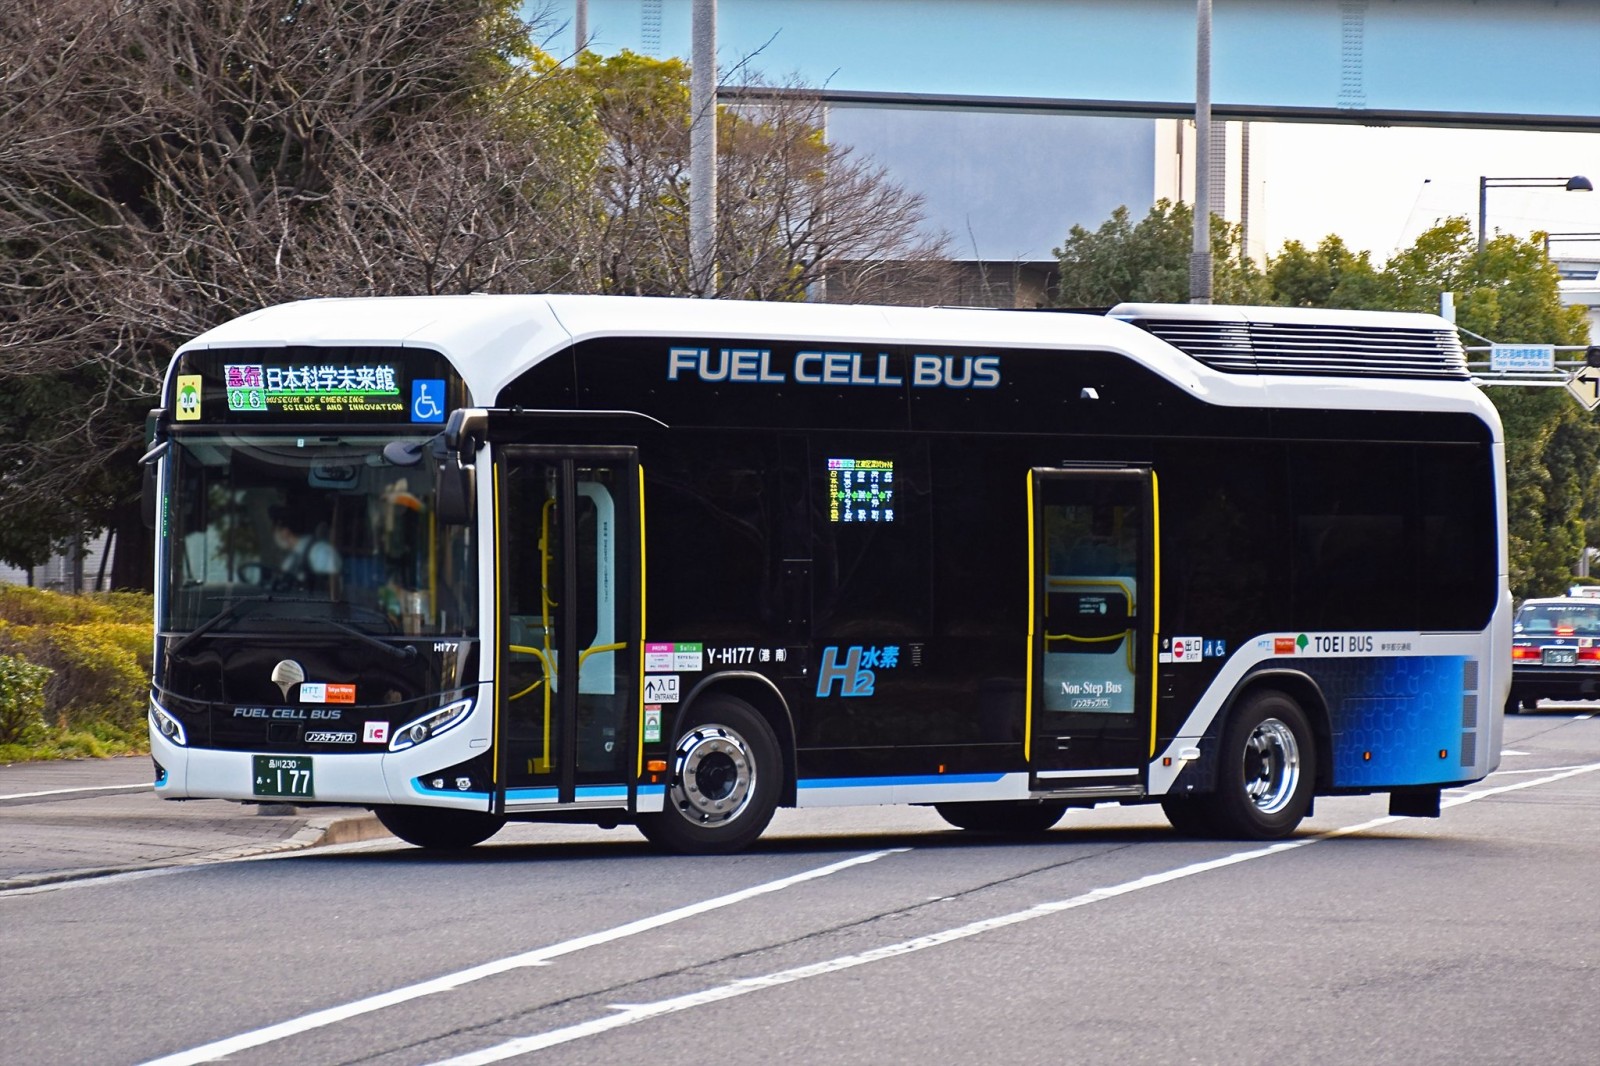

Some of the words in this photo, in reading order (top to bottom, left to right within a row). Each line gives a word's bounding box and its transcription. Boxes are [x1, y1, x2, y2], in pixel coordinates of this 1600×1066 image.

[668, 348, 786, 382] FUEL
[794, 352, 902, 385] CELL
[913, 355, 1000, 389] BUS
[228, 366, 261, 387] 急行
[266, 365, 396, 391] 日本科学未来館
[232, 390, 260, 408] 06
[320, 396, 365, 404] EMERGING
[433, 643, 459, 652] H177
[1185, 640, 1201, 651] 出口
[1315, 637, 1345, 653] TOEI
[1349, 636, 1373, 652] BUS
[707, 647, 755, 664] Y-H177
[861, 646, 899, 668] 水素
[657, 679, 676, 691] 入口
[1105, 682, 1122, 694] Bus
[655, 693, 678, 701] ENTRANCE
[1074, 699, 1109, 707] ノンステップバス
[233, 708, 269, 718] FUEL
[272, 709, 307, 719] CELL
[310, 710, 341, 719] BUS
[308, 733, 353, 742] ノンステップバス
